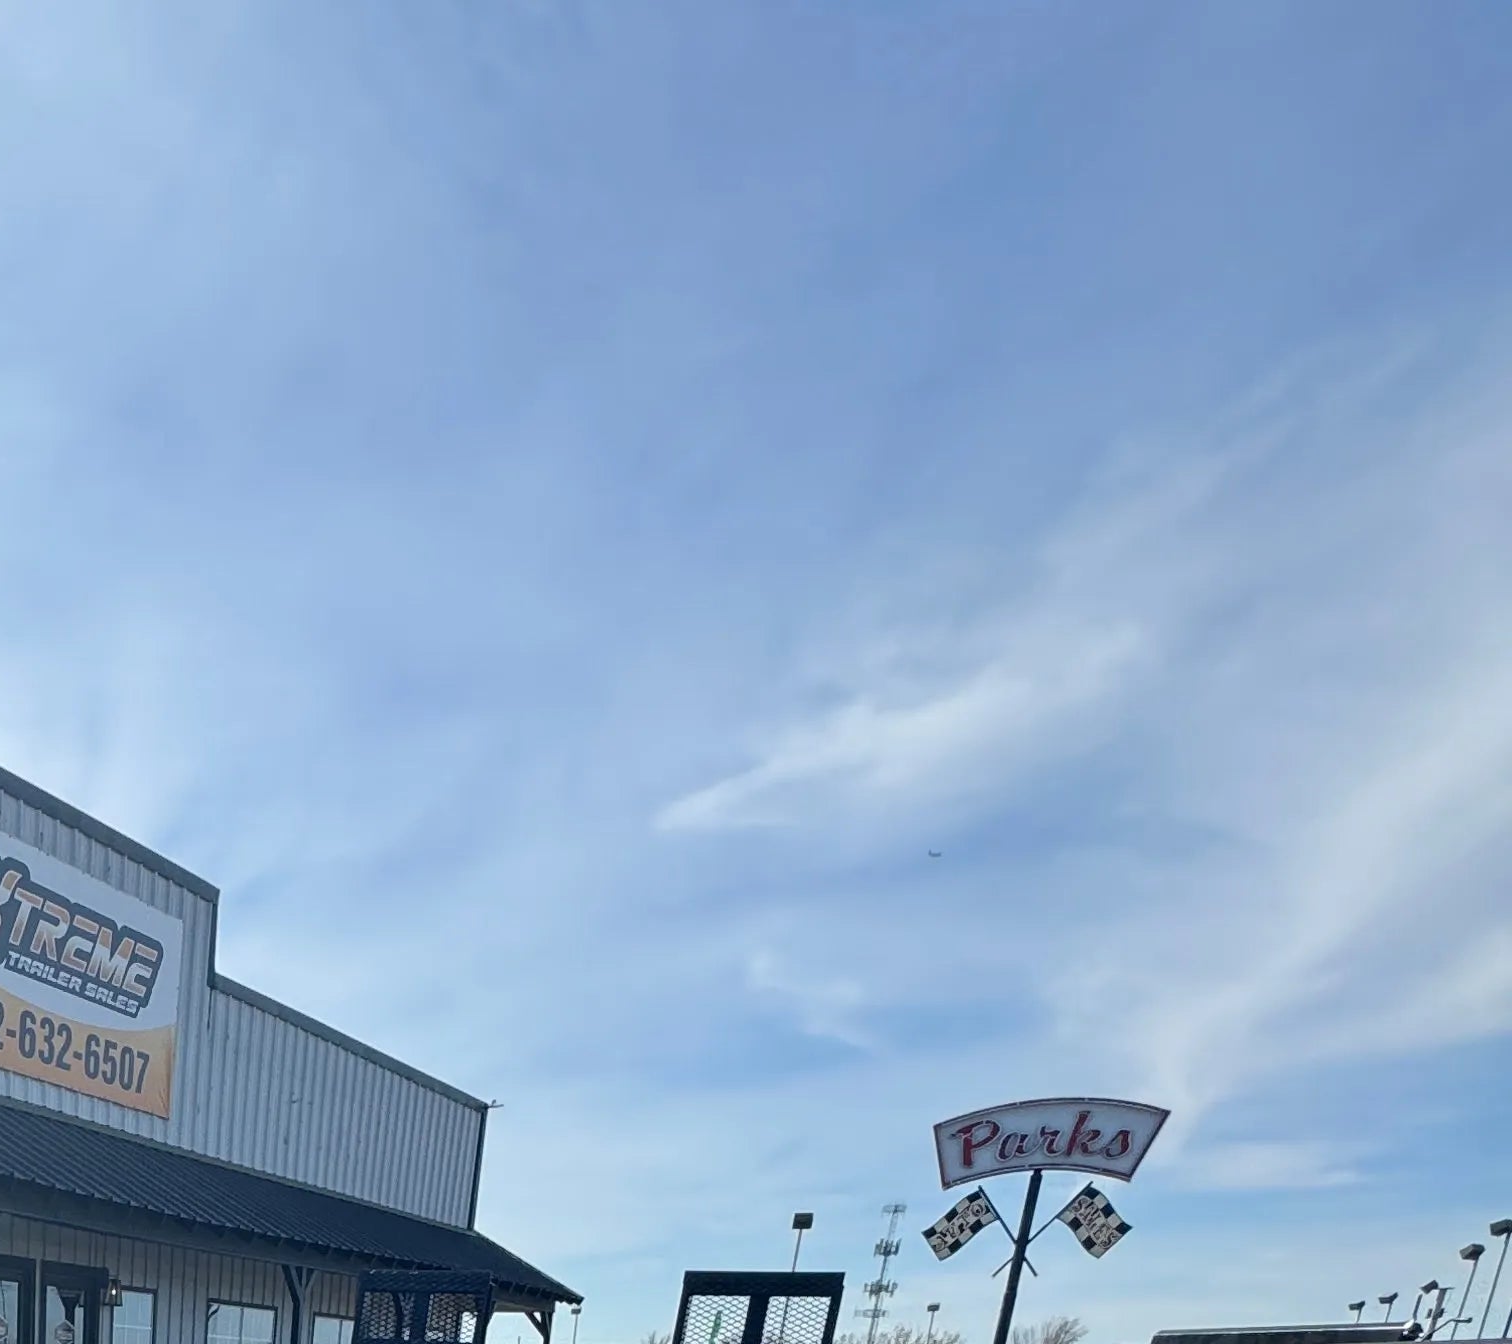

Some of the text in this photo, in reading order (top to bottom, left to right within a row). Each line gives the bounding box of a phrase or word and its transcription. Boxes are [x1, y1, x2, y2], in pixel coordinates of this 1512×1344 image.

[6, 950, 142, 1014] TRAILER SALES
[949, 1109, 1133, 1170] Parks
[1070, 1194, 1120, 1249] SALES
